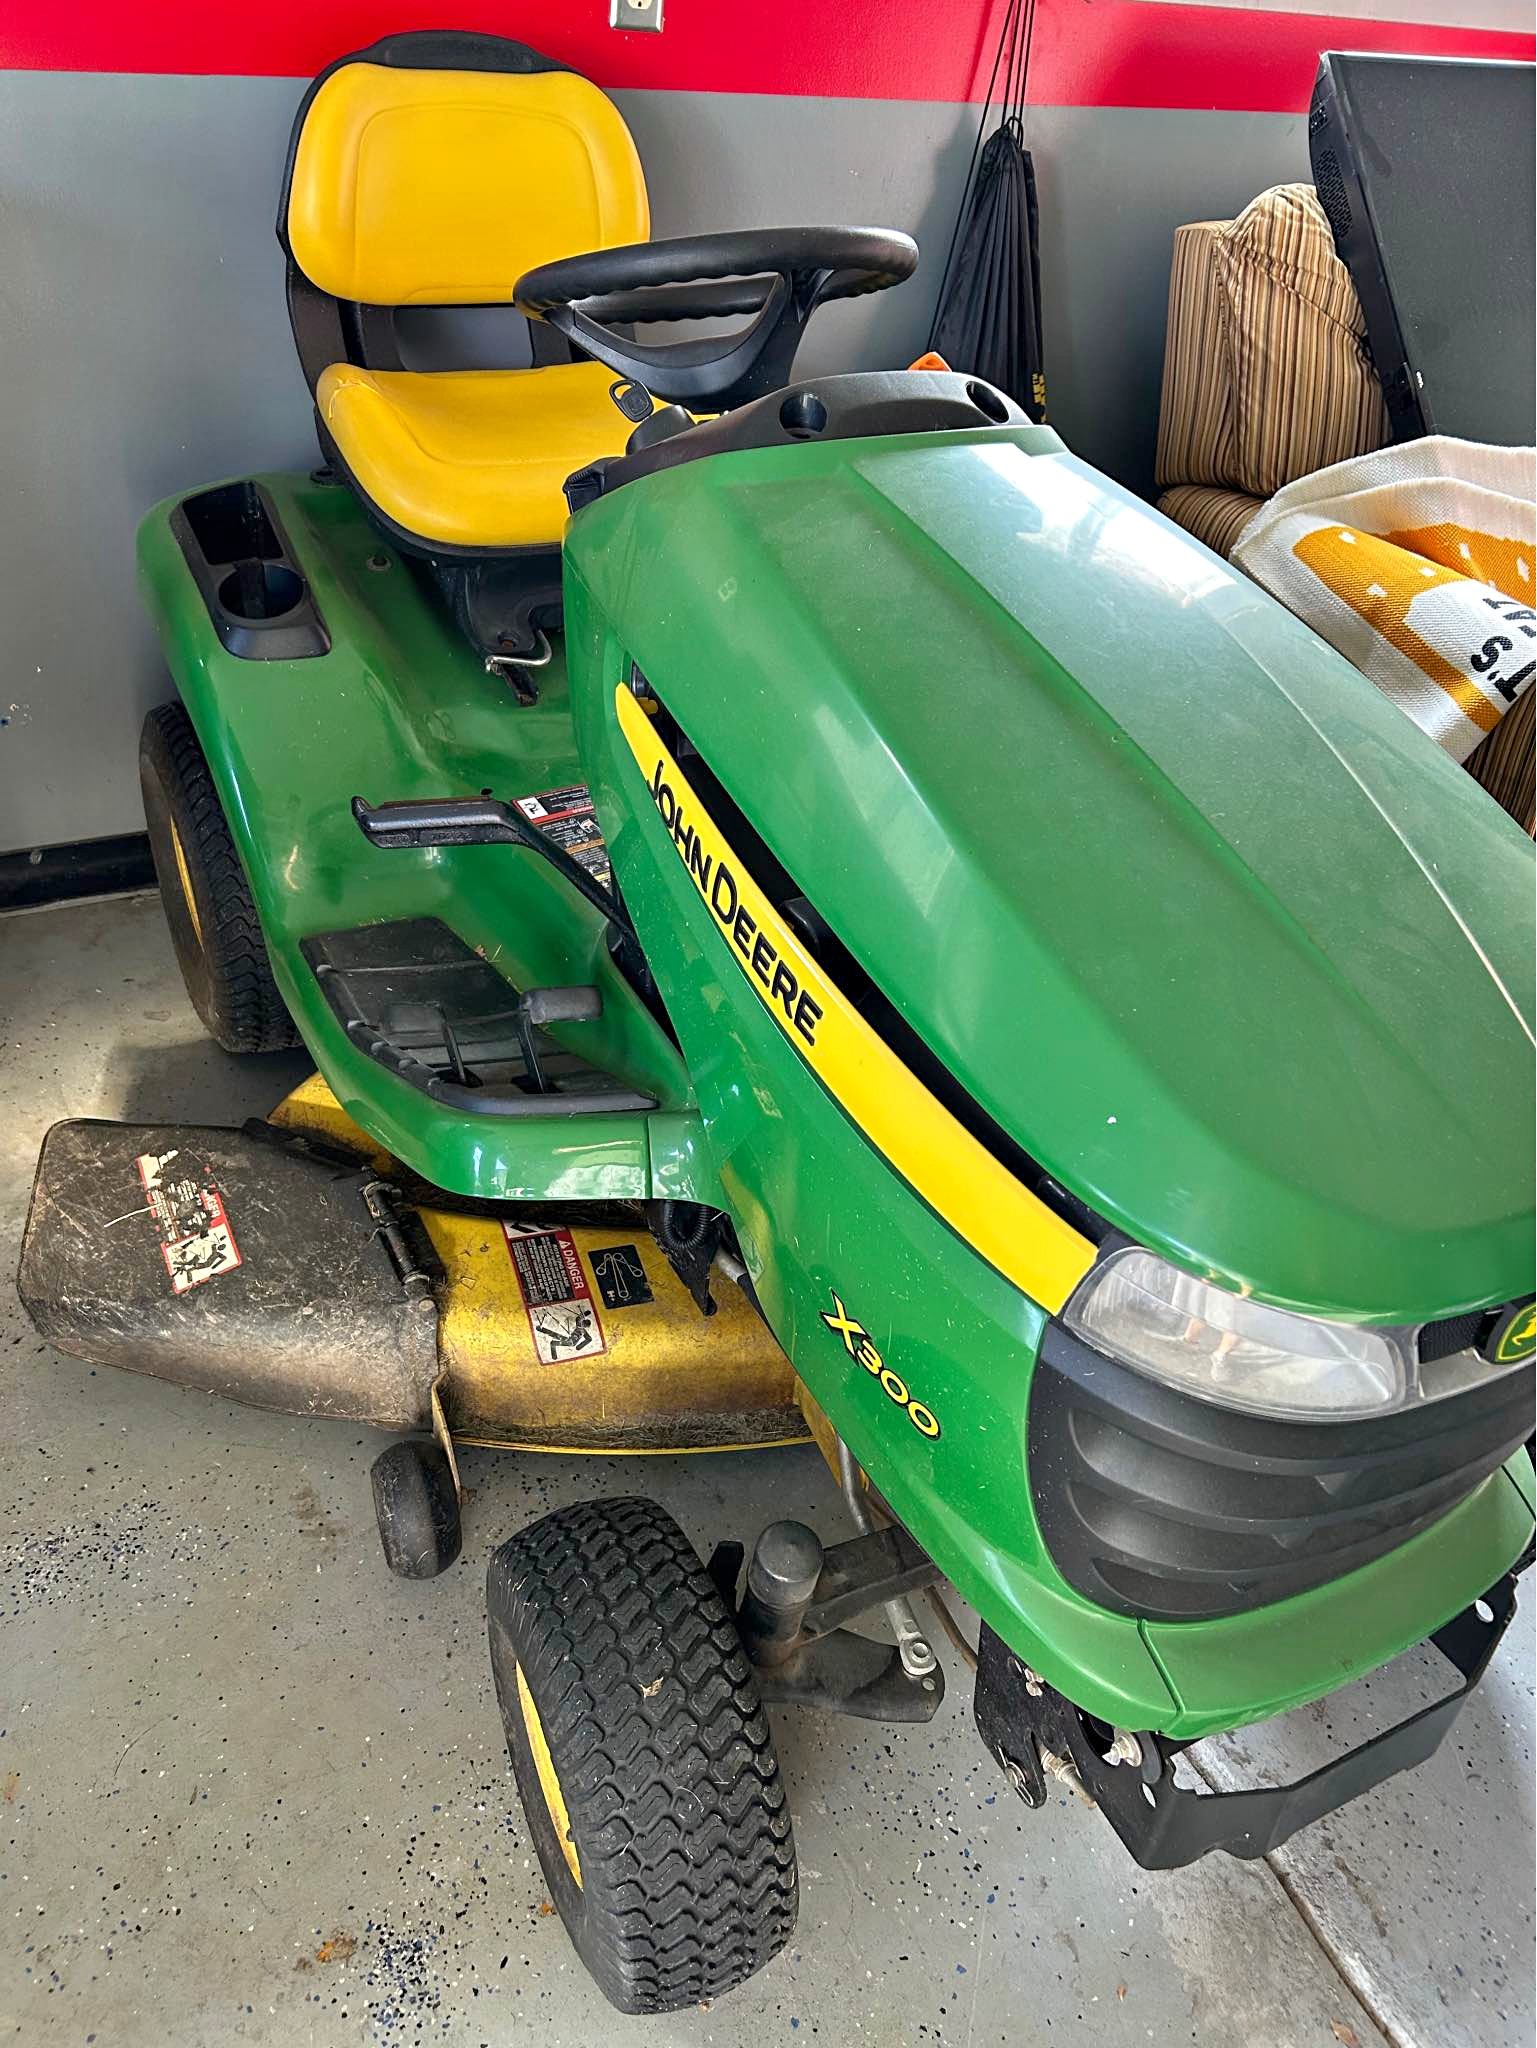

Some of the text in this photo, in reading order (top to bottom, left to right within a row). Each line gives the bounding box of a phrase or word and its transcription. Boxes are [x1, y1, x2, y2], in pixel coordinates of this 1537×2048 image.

[647, 760, 823, 1046] JOHN DEERE
[563, 1249, 585, 1289] DANGER
[820, 1288, 941, 1440] X300
